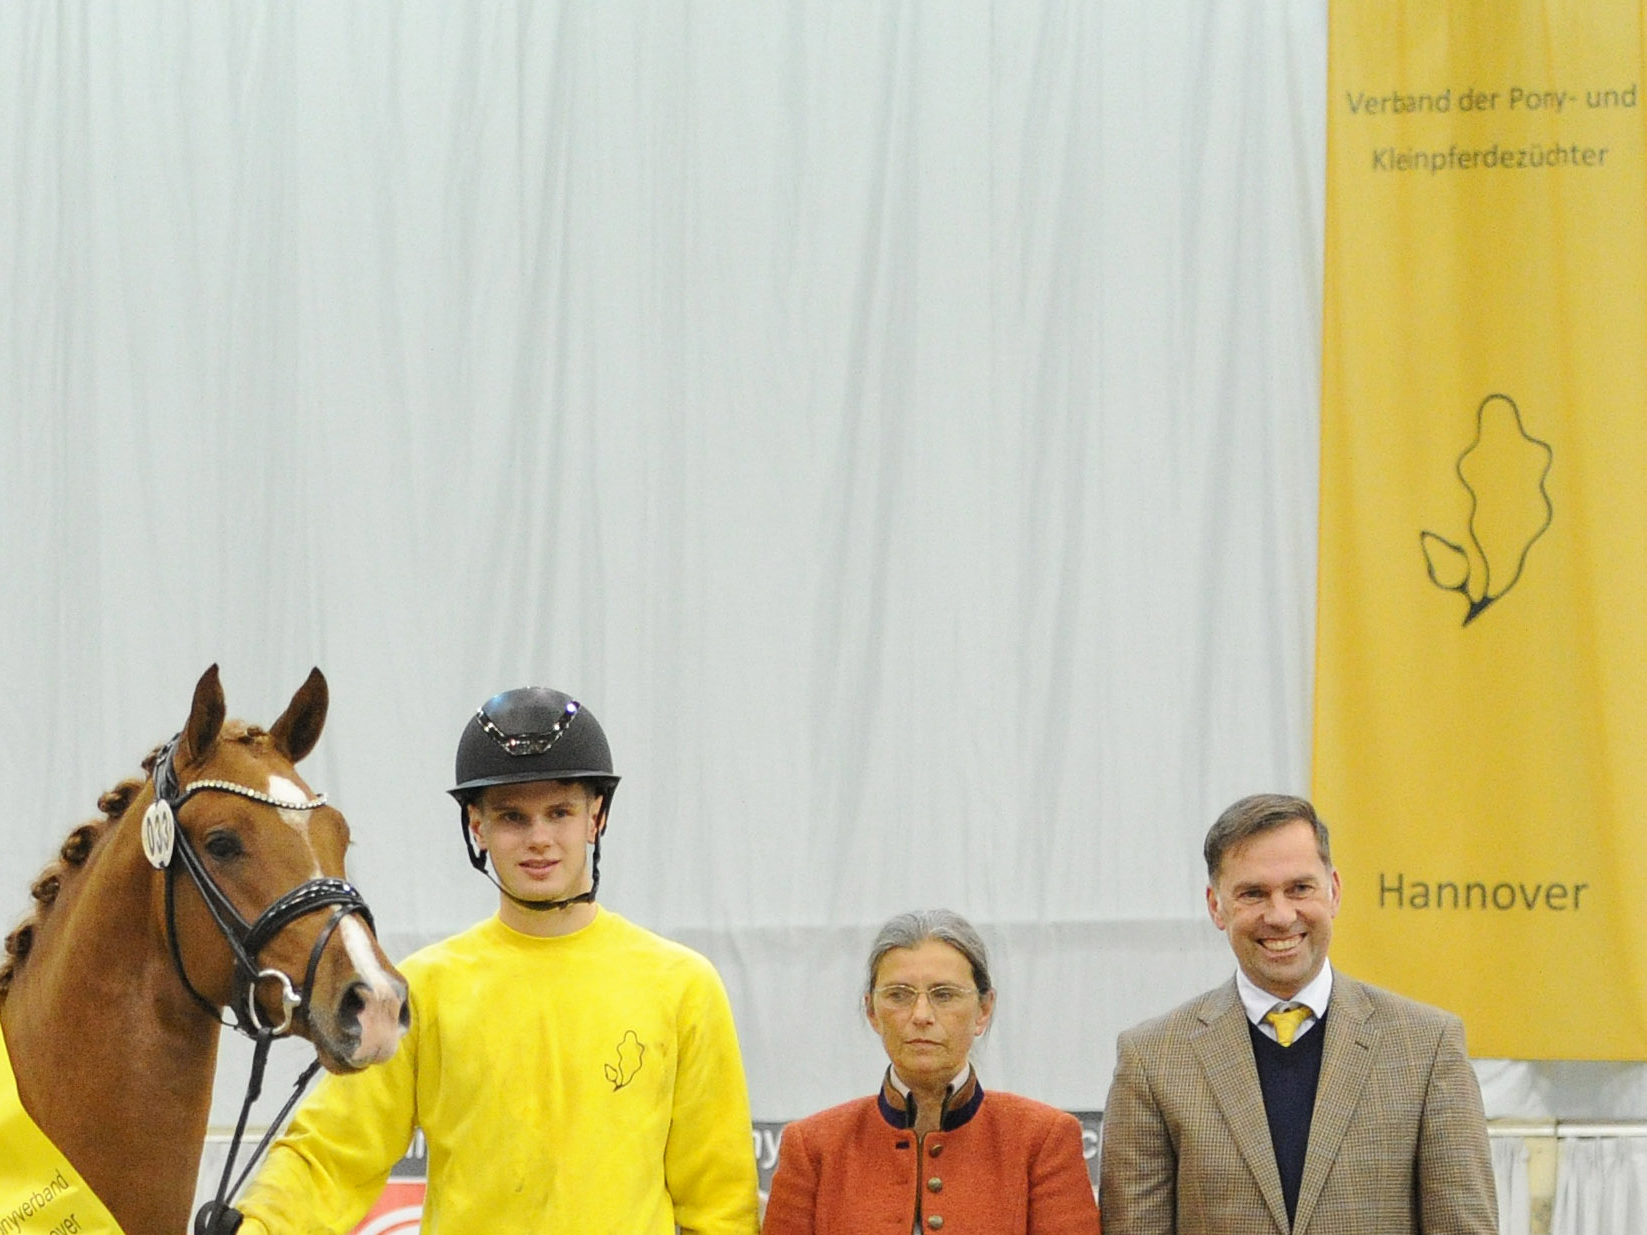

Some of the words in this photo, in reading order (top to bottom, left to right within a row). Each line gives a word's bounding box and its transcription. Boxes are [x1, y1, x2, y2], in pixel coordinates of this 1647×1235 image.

[1346, 89, 1452, 115] Verband
[1458, 87, 1501, 112] der
[1509, 87, 1578, 113] Pony-
[1586, 84, 1638, 109] und
[1372, 144, 1610, 175] Kleinpferdezüchter
[1379, 873, 1590, 911] Hannover
